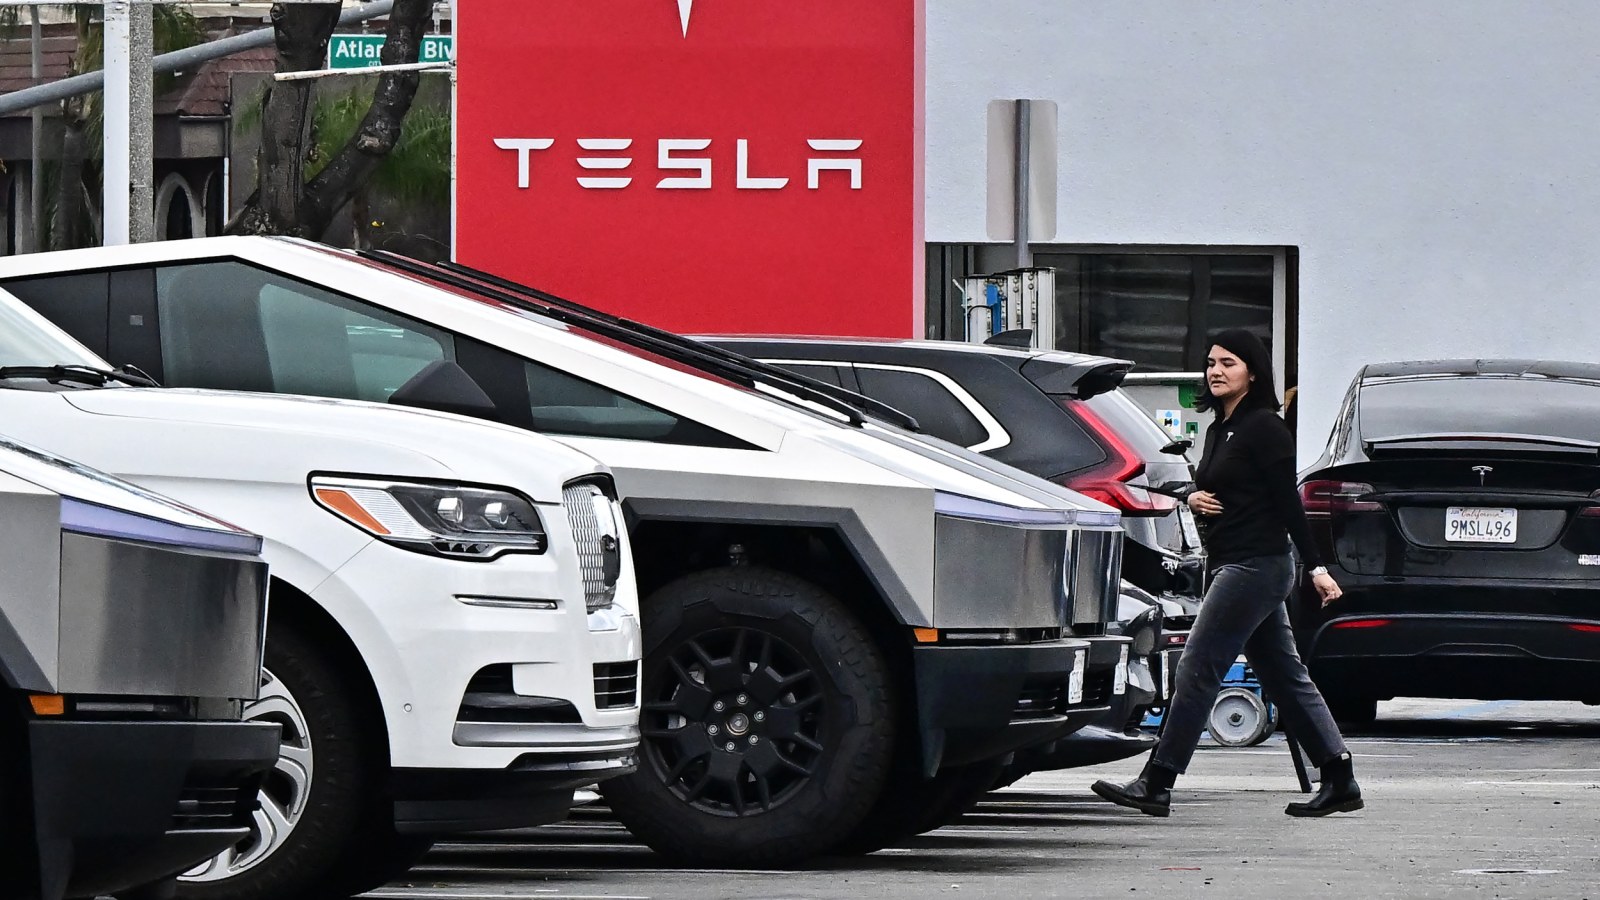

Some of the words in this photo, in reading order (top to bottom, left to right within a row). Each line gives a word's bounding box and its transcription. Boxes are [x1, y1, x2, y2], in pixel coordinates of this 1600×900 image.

[335, 40, 383, 58] Atla
[424, 41, 452, 59] Blv
[493, 138, 863, 189] TESLA
[1461, 508, 1501, 520] California
[1450, 519, 1512, 537] 9MSL496
